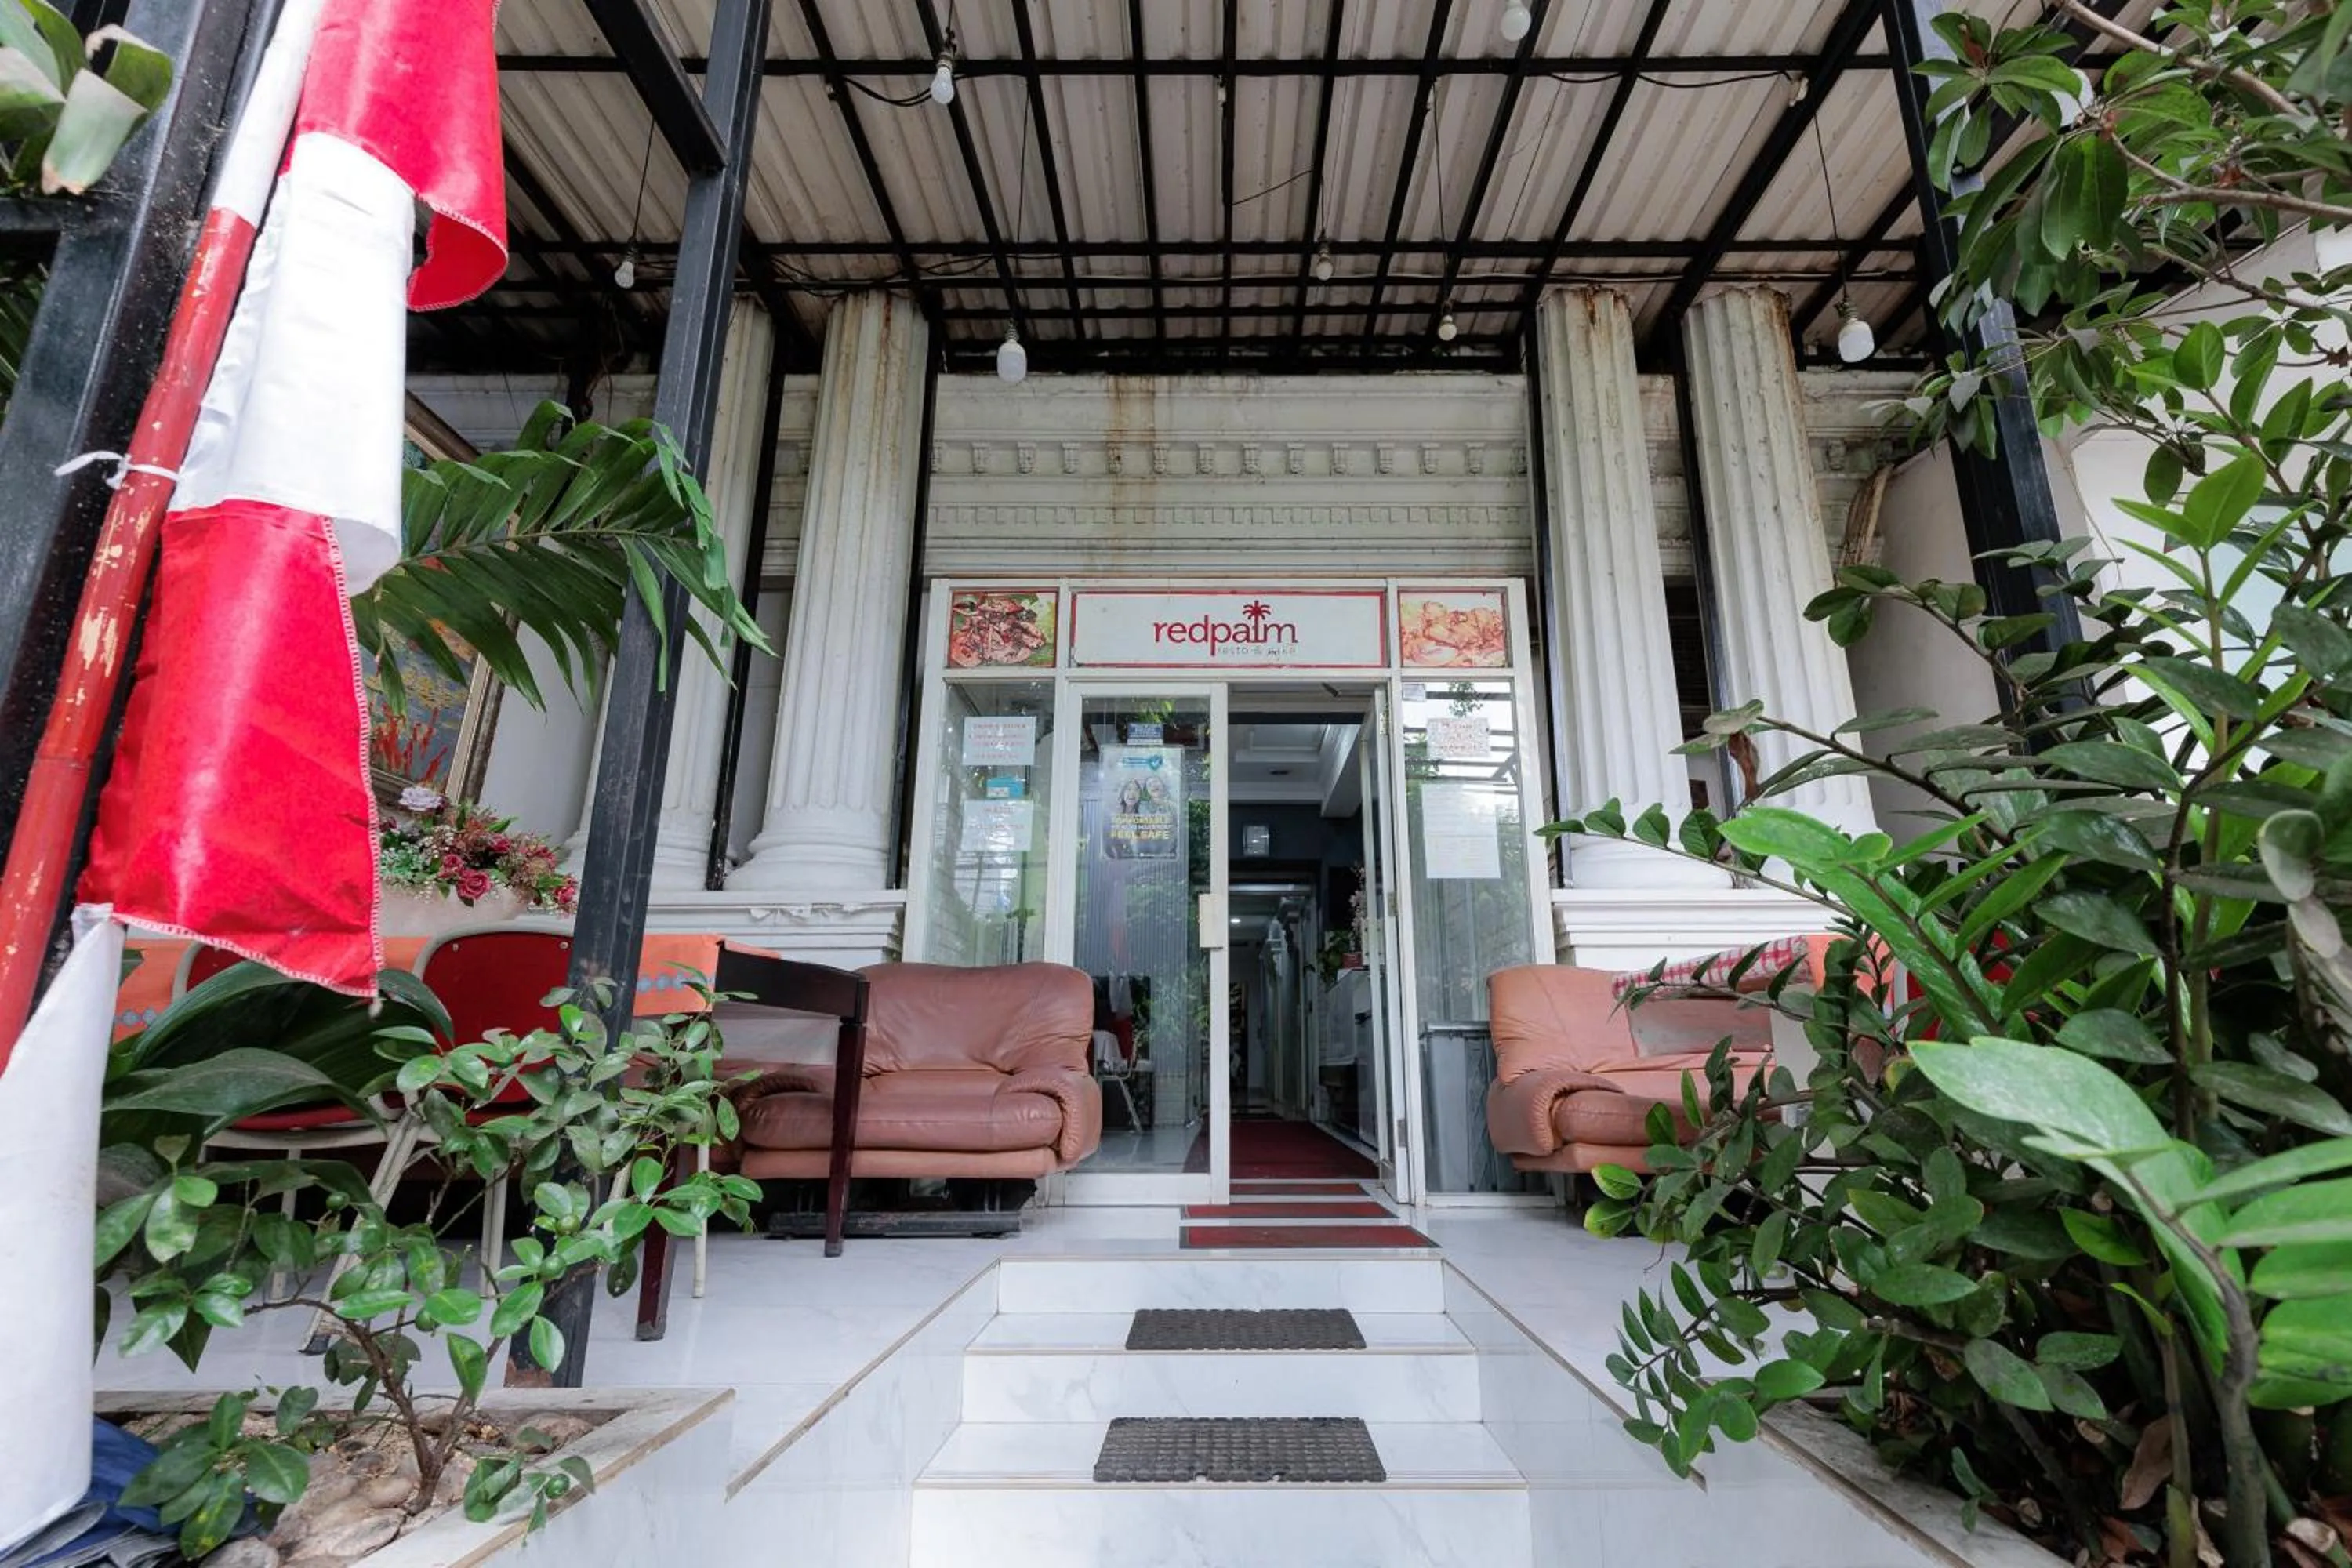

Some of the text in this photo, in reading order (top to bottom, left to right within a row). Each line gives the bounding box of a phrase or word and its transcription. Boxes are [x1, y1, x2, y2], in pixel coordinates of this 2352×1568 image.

[1153, 600, 1298, 656] redpalm
[1111, 829, 1171, 840] FEEL SAFE
